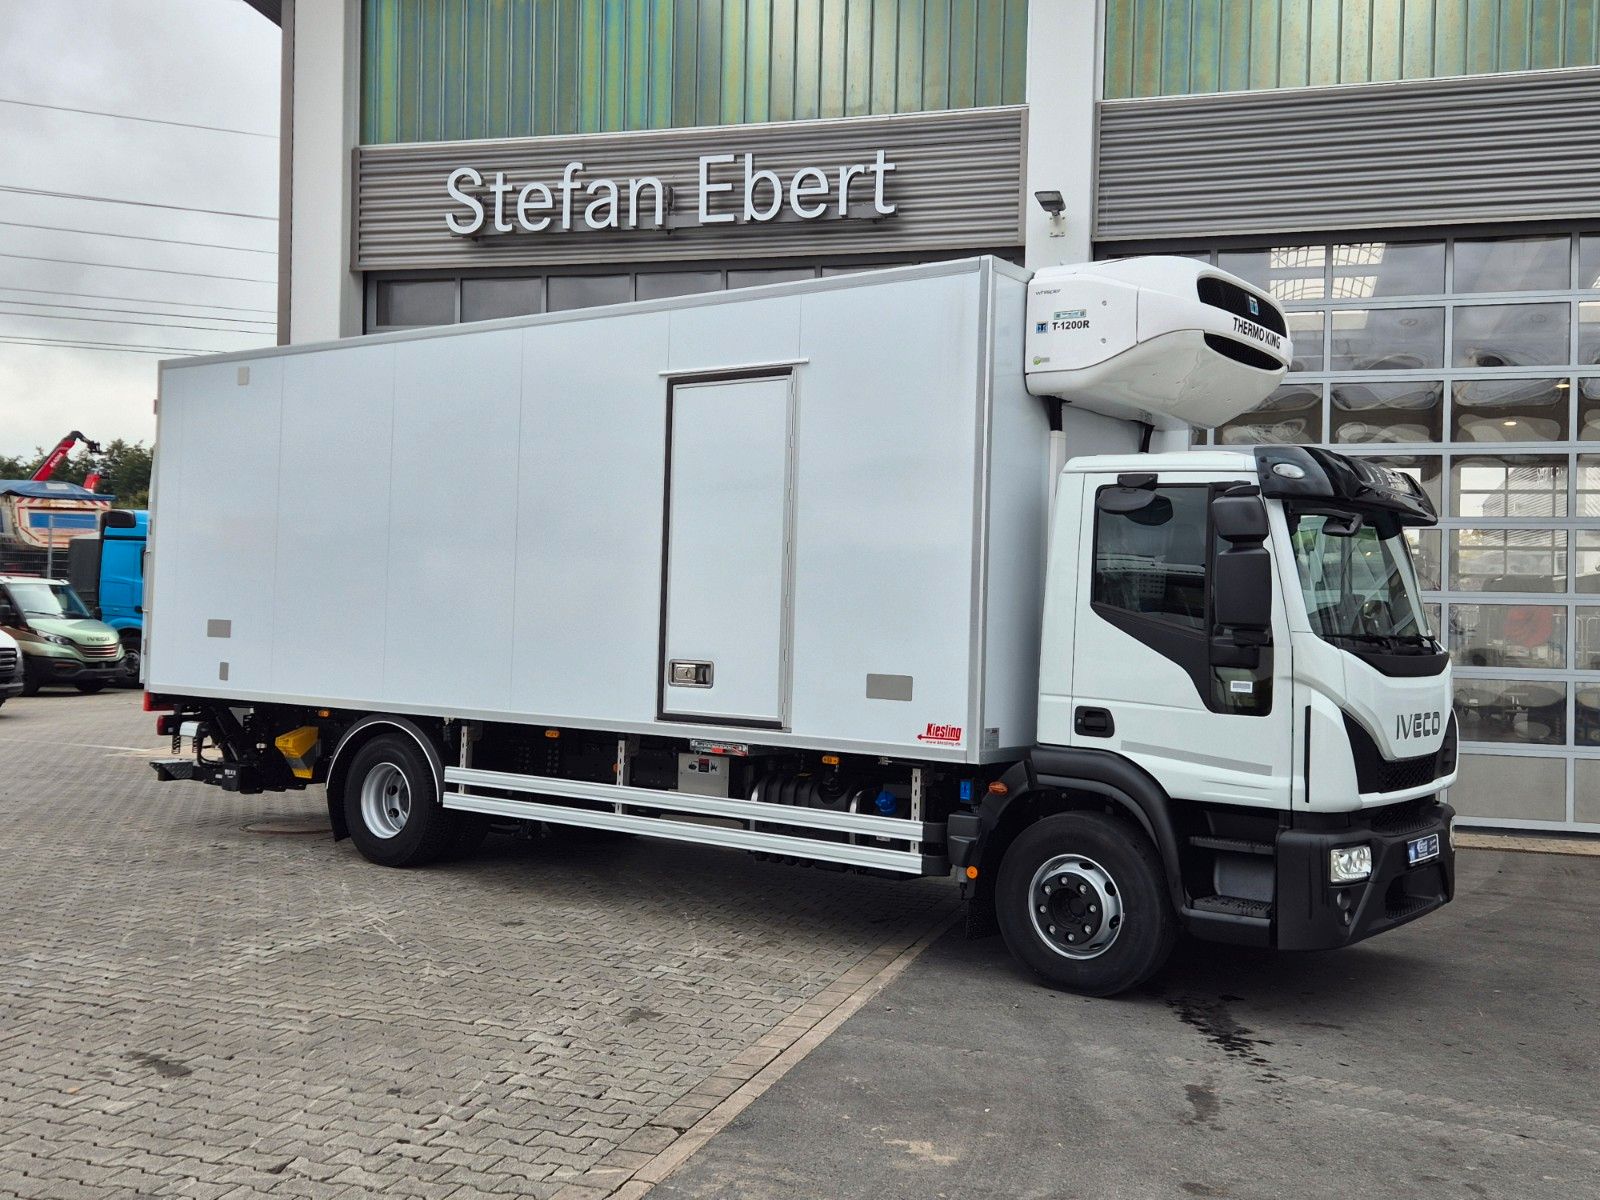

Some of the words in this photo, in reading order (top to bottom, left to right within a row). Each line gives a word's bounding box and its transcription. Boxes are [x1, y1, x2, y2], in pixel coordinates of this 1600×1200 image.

[445, 162, 664, 235] Stefan
[699, 149, 897, 224] Ebert
[1052, 320, 1090, 331] T-1200R
[1233, 316, 1265, 341] THERMO
[1265, 331, 1281, 350] KING
[926, 723, 962, 740] Kiesling
[1396, 711, 1441, 740] IVECO
